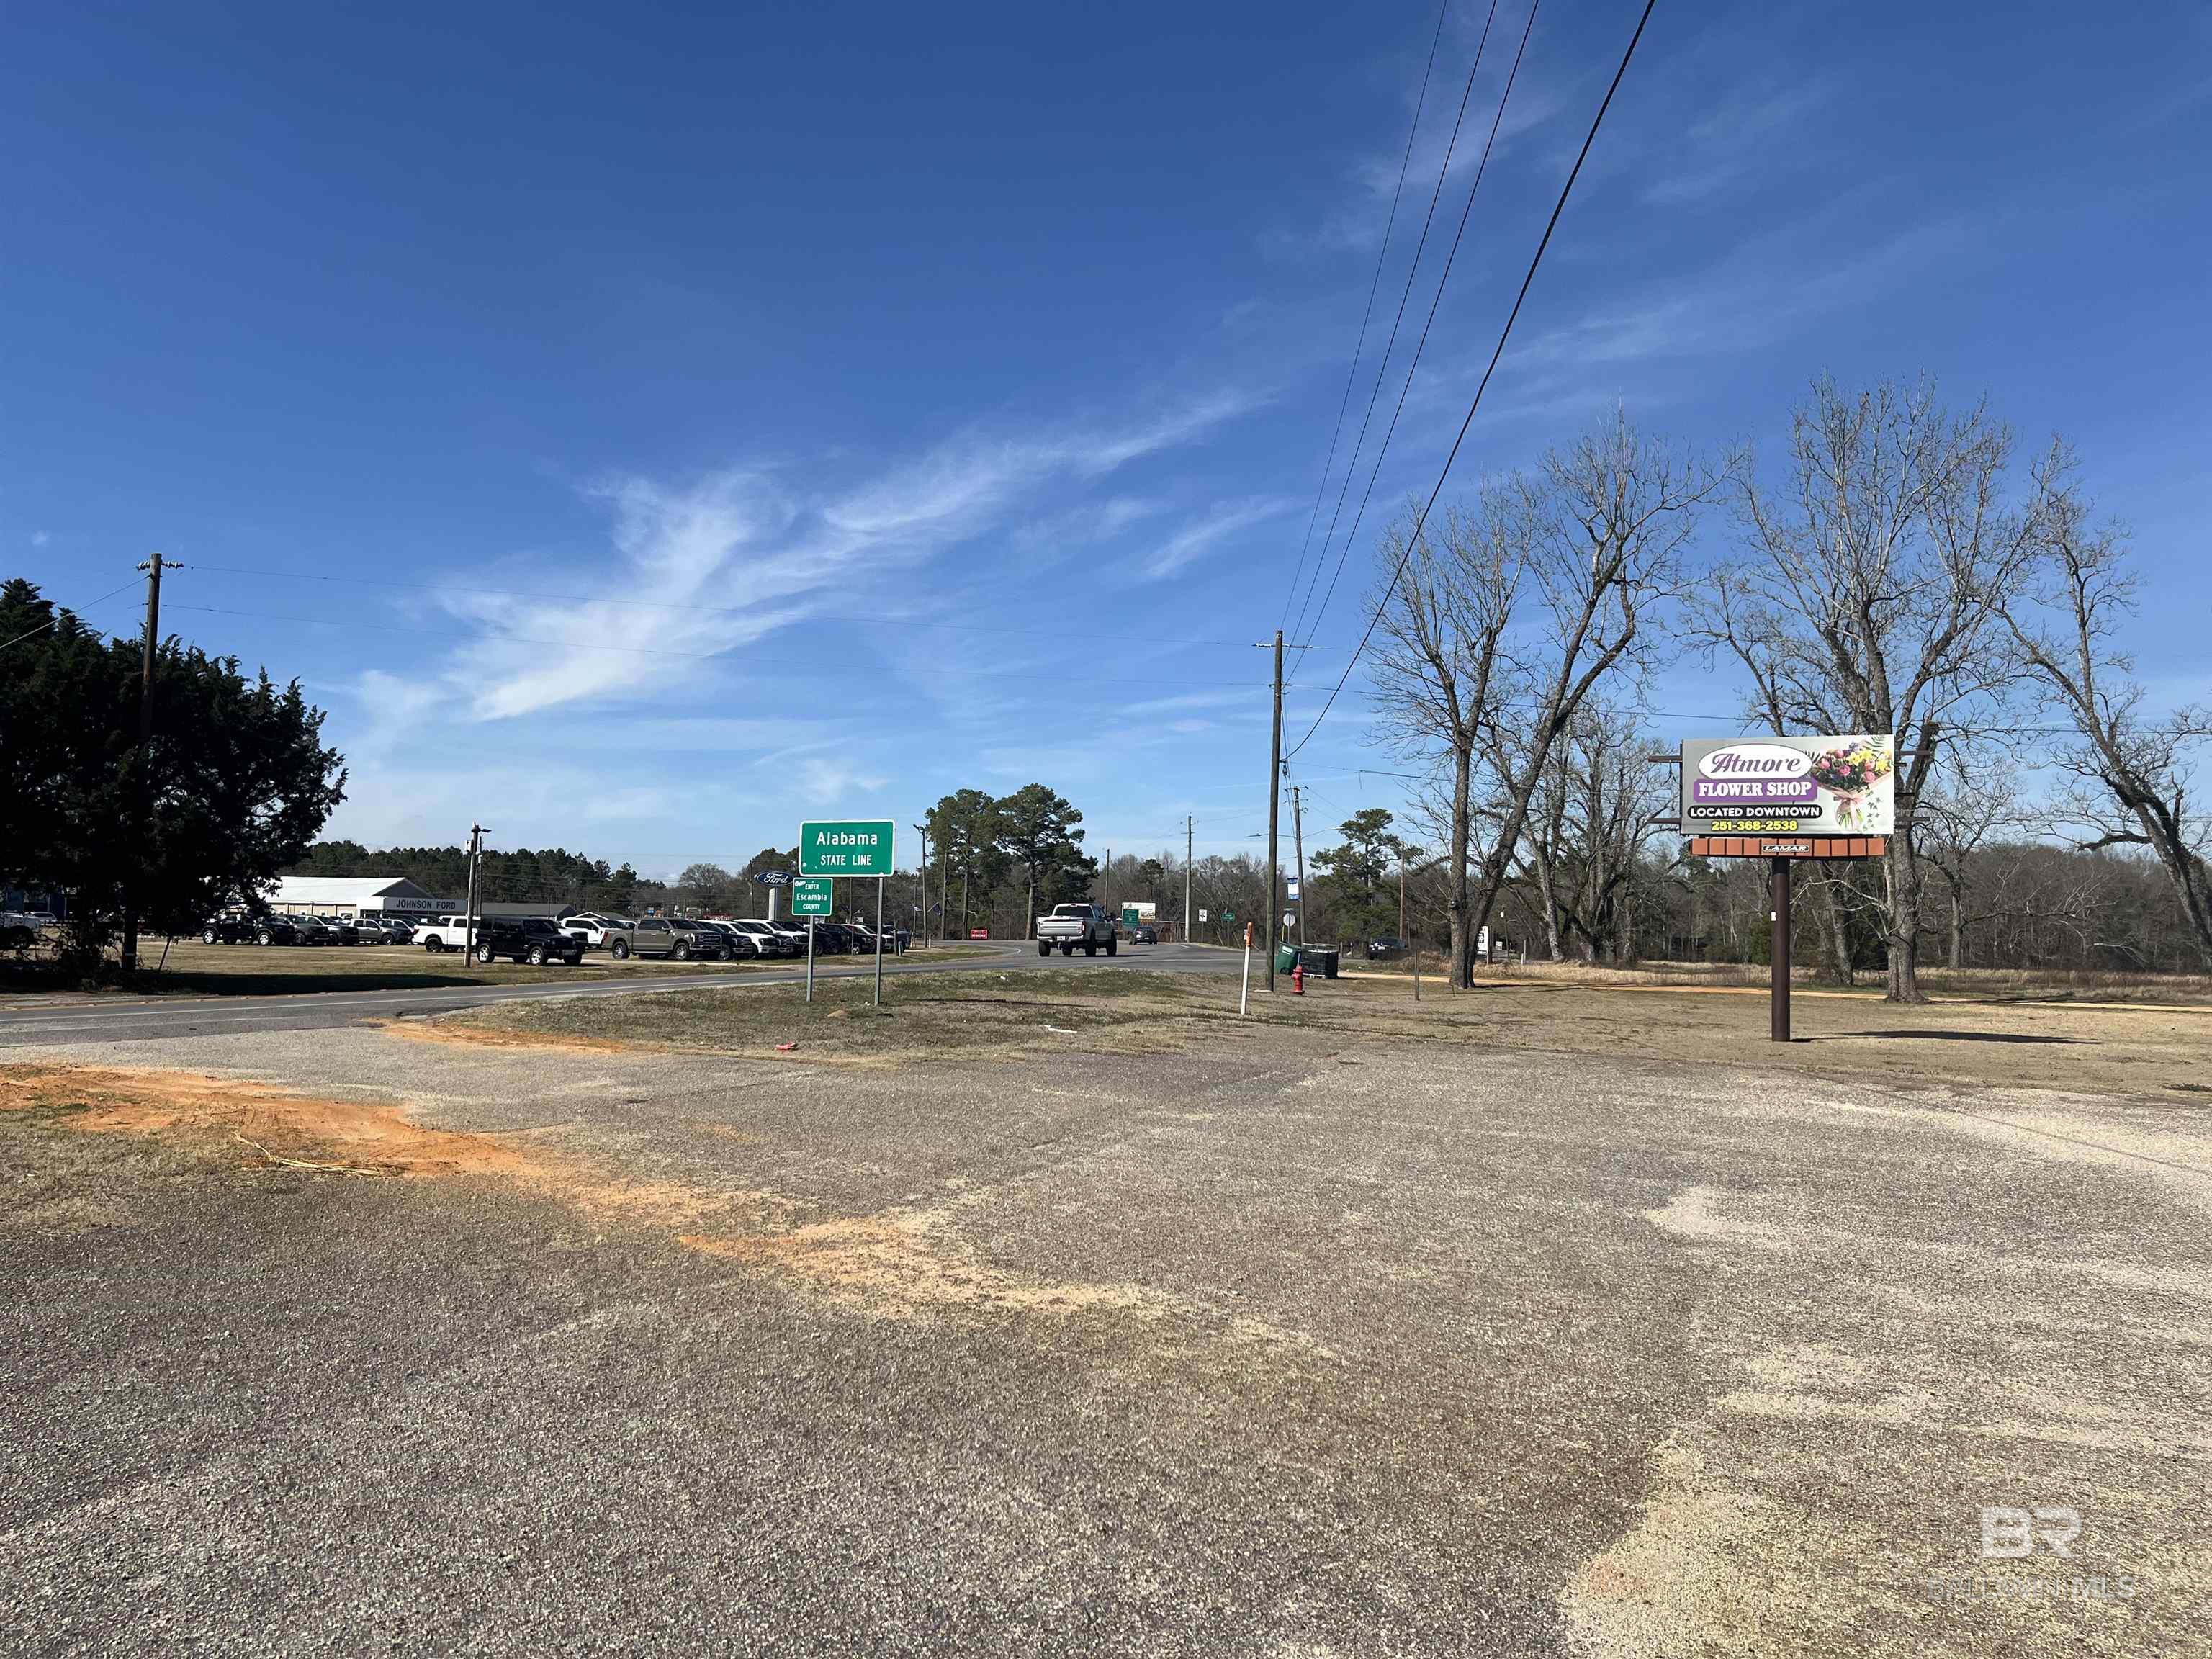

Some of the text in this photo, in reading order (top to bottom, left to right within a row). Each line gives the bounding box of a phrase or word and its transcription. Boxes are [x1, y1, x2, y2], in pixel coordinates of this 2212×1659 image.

[1710, 753, 1802, 773] Atmore
[1699, 781, 1812, 796] FLOWER SHOP
[1690, 806, 1820, 817] LOCATED DOWNTOWN
[1711, 820, 1798, 831] 251-368-2538
[816, 831, 878, 845] Alabama
[820, 855, 872, 866] STATE LINE
[763, 872, 789, 884] Ford
[796, 893, 827, 902] Escambia
[396, 899, 456, 910] JOHNSON FORD
